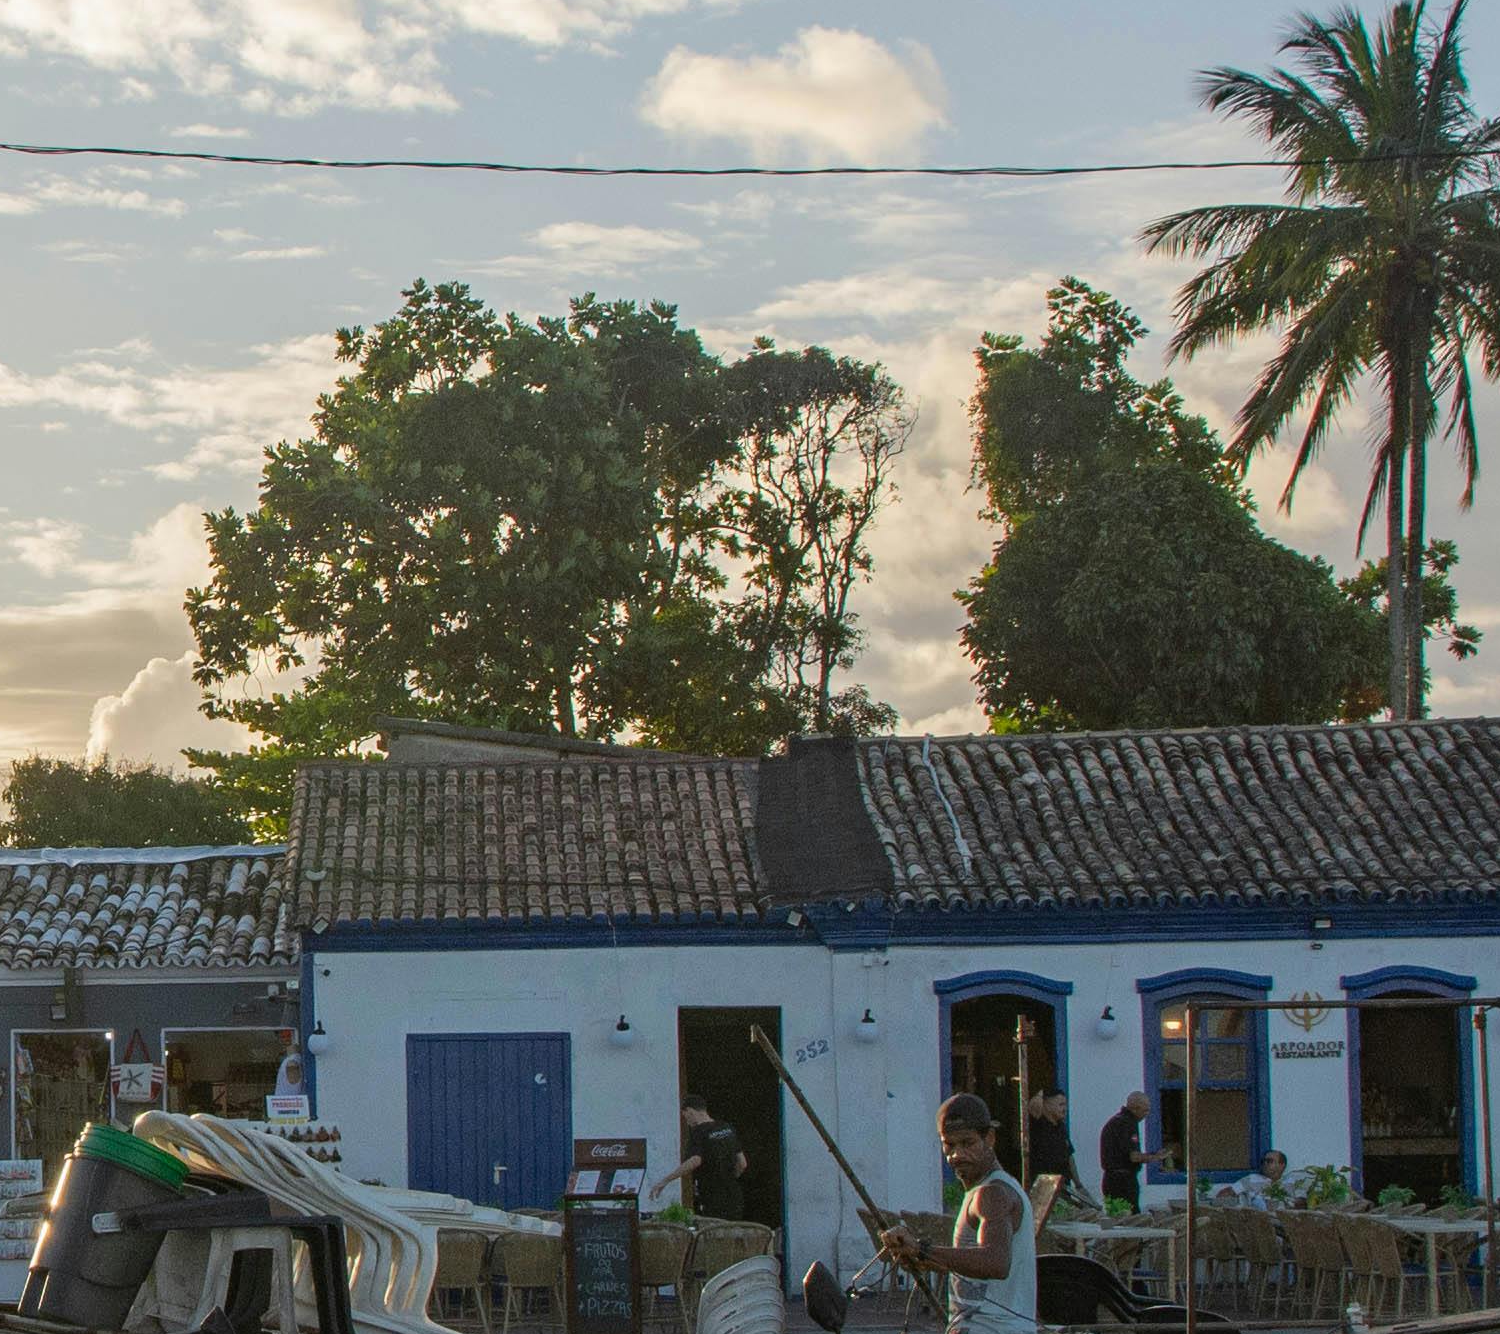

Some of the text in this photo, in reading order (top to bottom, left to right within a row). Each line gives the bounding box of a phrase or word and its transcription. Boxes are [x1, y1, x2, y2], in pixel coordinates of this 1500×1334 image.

[796, 1038, 830, 1064] 252
[1271, 1041, 1344, 1052] ARPOADOR
[1275, 1050, 1341, 1059] RESTAURANTE
[591, 1144, 629, 1158] Coca-Cola
[584, 1242, 628, 1261] FRUTOS
[585, 1281, 629, 1297] CARNES
